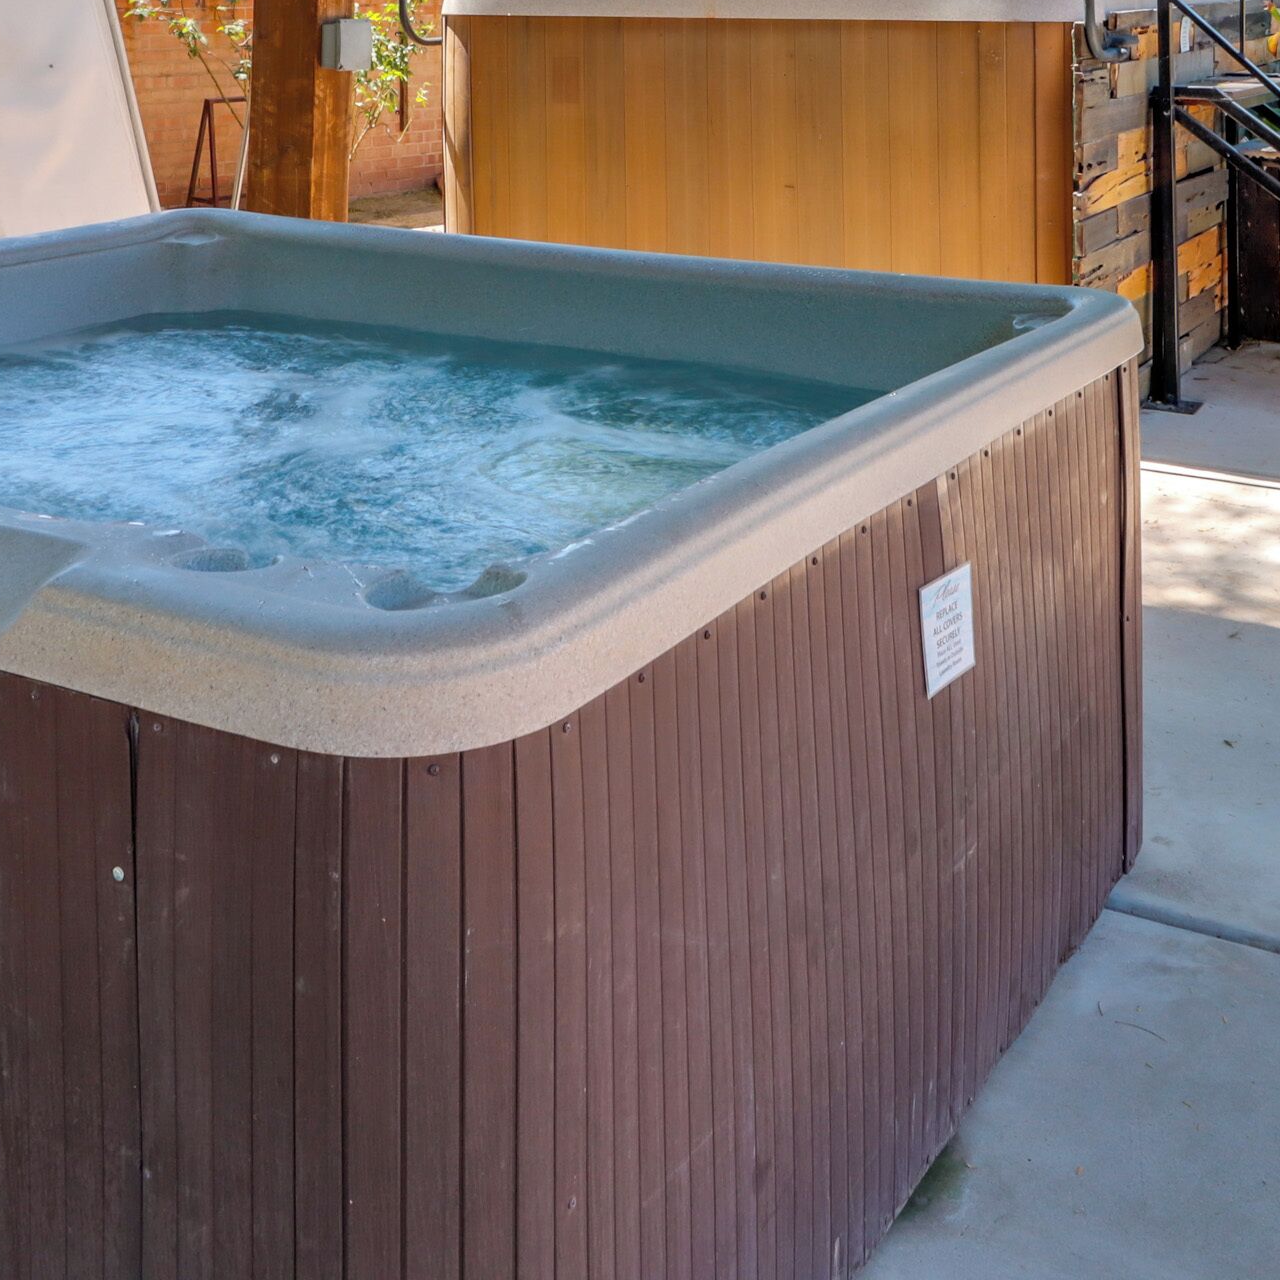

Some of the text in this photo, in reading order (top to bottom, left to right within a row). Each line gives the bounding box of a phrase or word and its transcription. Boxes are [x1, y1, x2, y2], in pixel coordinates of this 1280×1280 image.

[932, 579, 960, 608] Please
[936, 600, 959, 620] REPLACE
[933, 612, 963, 636] ALL COVERS
[936, 626, 961, 648] SECURELY
